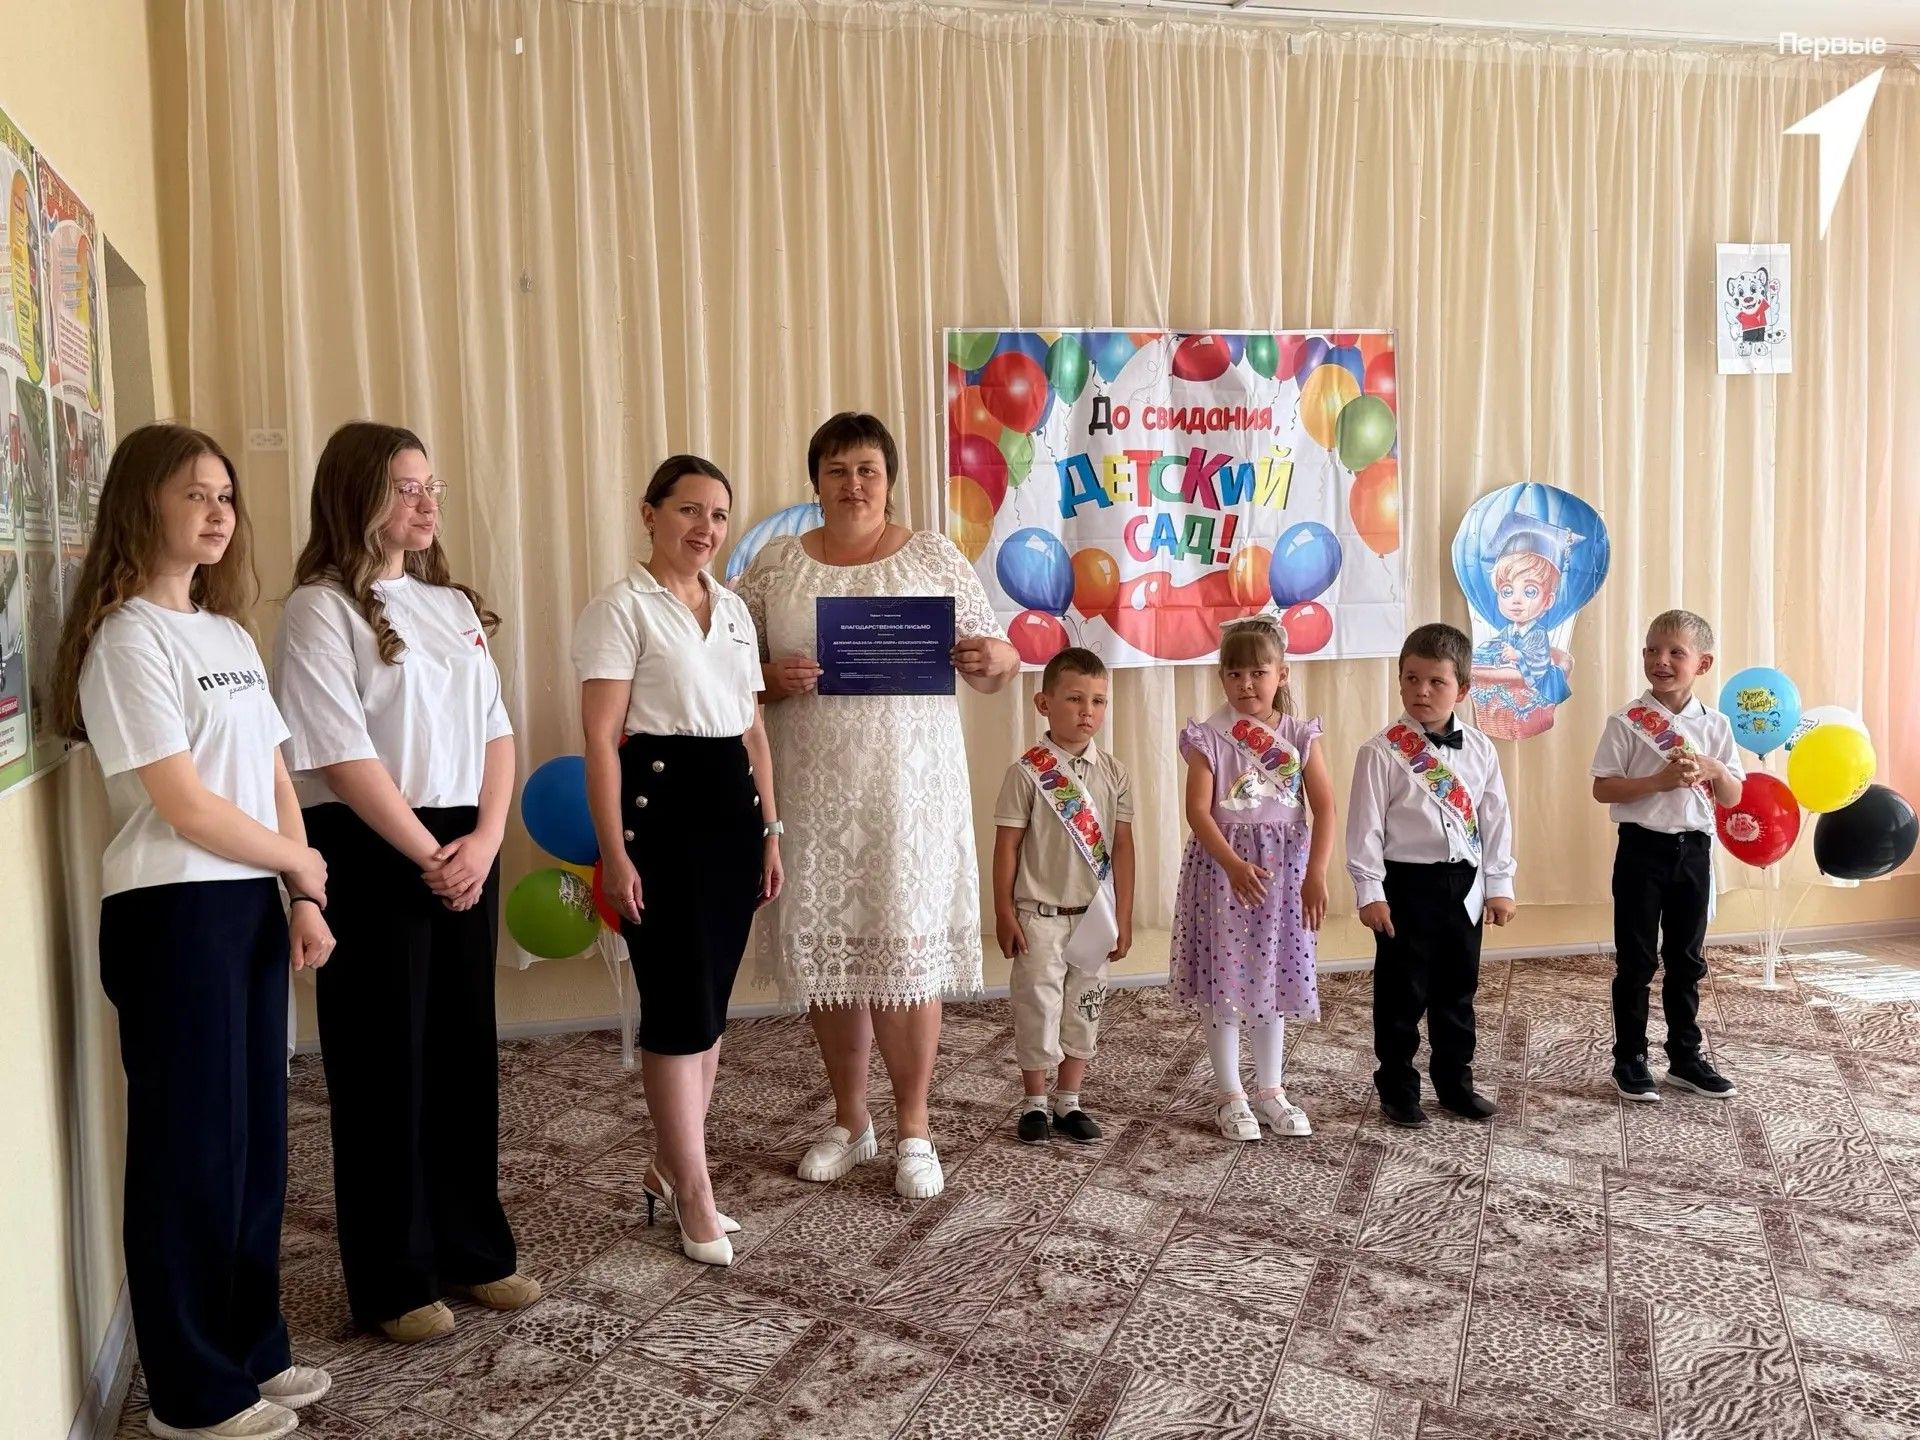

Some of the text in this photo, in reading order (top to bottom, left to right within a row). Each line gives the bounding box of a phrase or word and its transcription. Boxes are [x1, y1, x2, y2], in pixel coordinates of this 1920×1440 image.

[1088, 396, 1280, 436] До свидания,
[1056, 445, 1294, 519] ДЕТСКИЙ
[1123, 513, 1239, 565] САД!
[1080, 983, 1106, 1004] HAPPY
